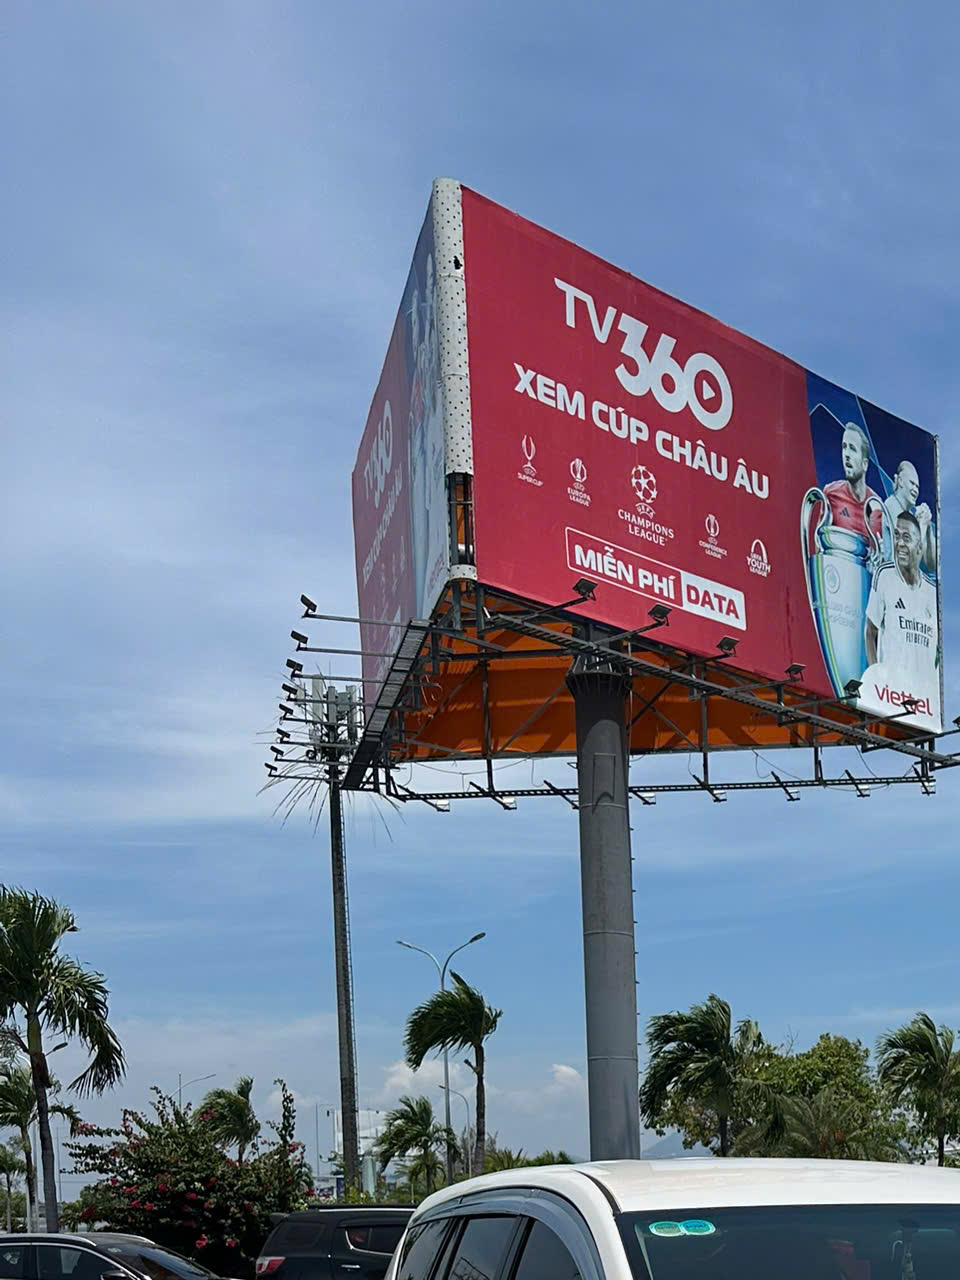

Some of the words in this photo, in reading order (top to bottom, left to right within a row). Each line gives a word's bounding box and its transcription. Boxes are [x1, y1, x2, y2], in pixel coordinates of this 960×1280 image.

[554, 277, 733, 431] TV360
[513, 362, 586, 421] XEM
[592, 400, 649, 444] CÚP
[656, 430, 728, 481] CHÂU
[733, 458, 769, 499] ÂU
[617, 509, 674, 539] CHAMPIONS
[628, 524, 665, 546] LEAGUE
[574, 544, 634, 585] MIỄN
[637, 568, 676, 600] PHÍ
[686, 584, 740, 620] DATA
[746, 556, 771, 573] YOUTH
